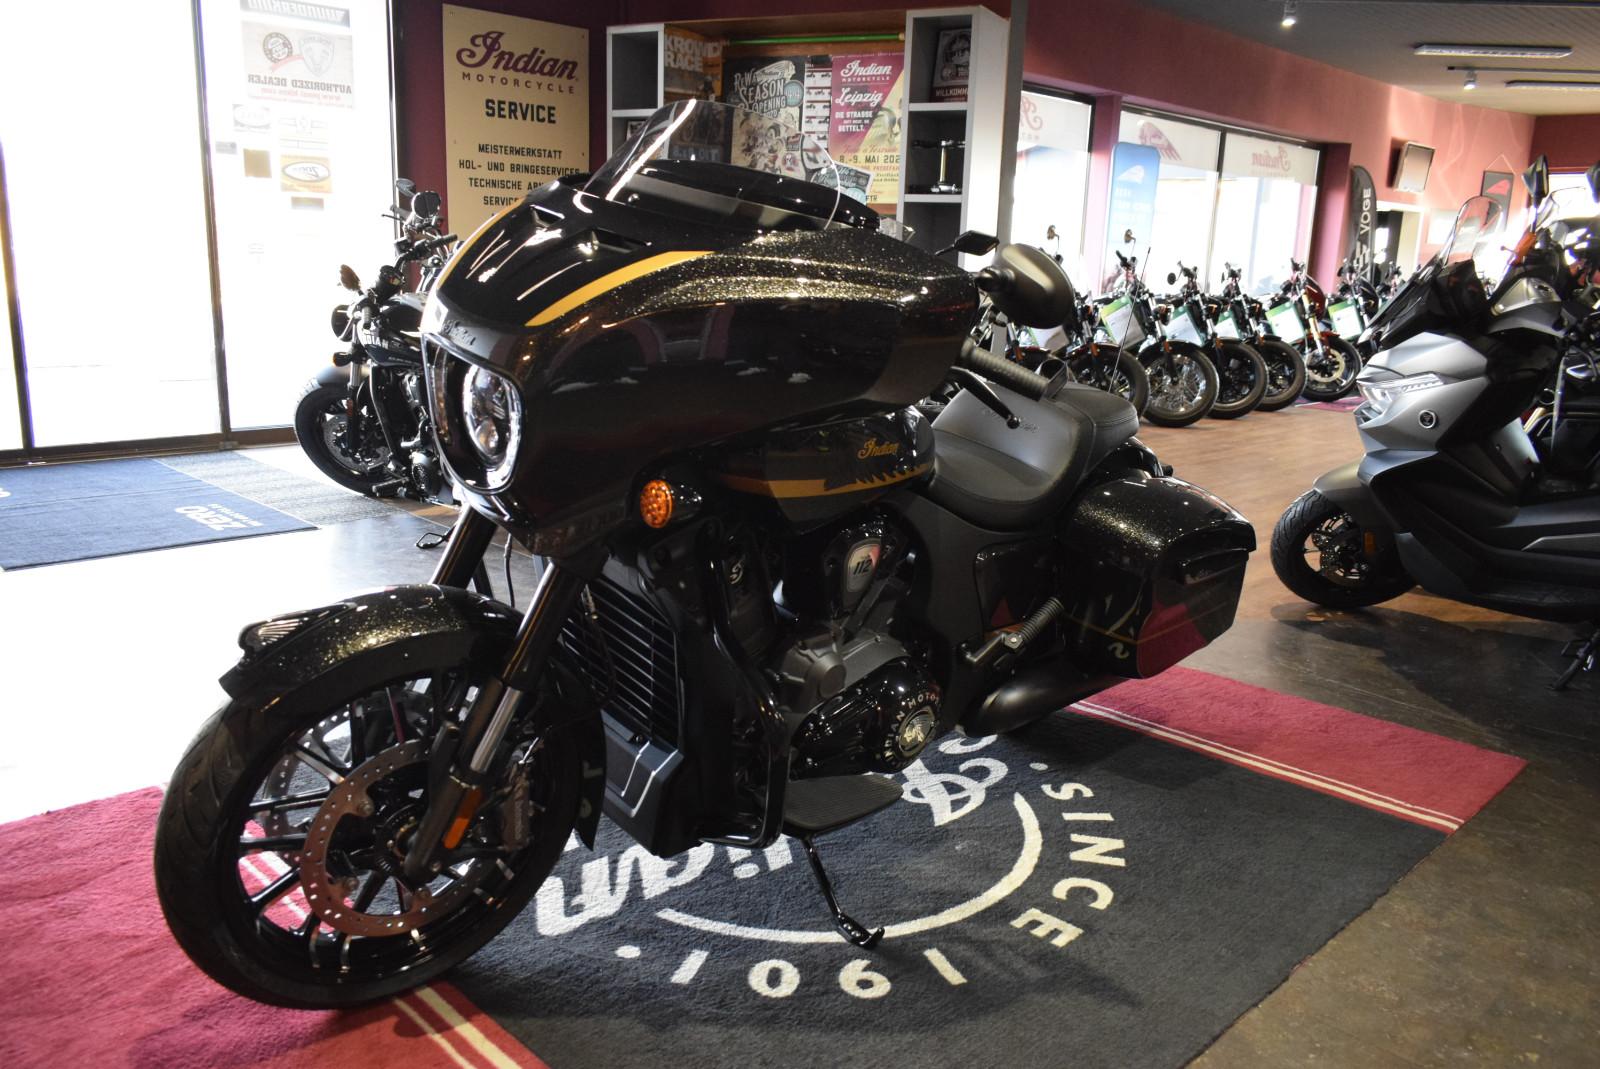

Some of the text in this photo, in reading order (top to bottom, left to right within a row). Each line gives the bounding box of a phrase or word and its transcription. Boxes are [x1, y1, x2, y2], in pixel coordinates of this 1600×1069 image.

[456, 30, 579, 81] Indian
[664, 50, 704, 73] RACE
[840, 60, 892, 77] Indian
[462, 71, 575, 94] MOTORCYCLE
[935, 87, 968, 97] WILLKOMM
[738, 79, 785, 113] SEASON
[752, 96, 787, 113] OPENING
[835, 87, 884, 107] Leipzig
[485, 98, 556, 124] SERVICE
[478, 144, 562, 160] MEISTERWERKSTATT
[865, 155, 879, 164] MAI
[883, 155, 901, 164] 202
[459, 159, 580, 177] HOL- UND BRINGESERVICES
[468, 178, 522, 190] TECHNISCHE
[1359, 187, 1372, 235] VOGE
[857, 438, 900, 460] Indian
[854, 558, 873, 575] 112
[670, 781, 1126, 999] SINCE 1901
